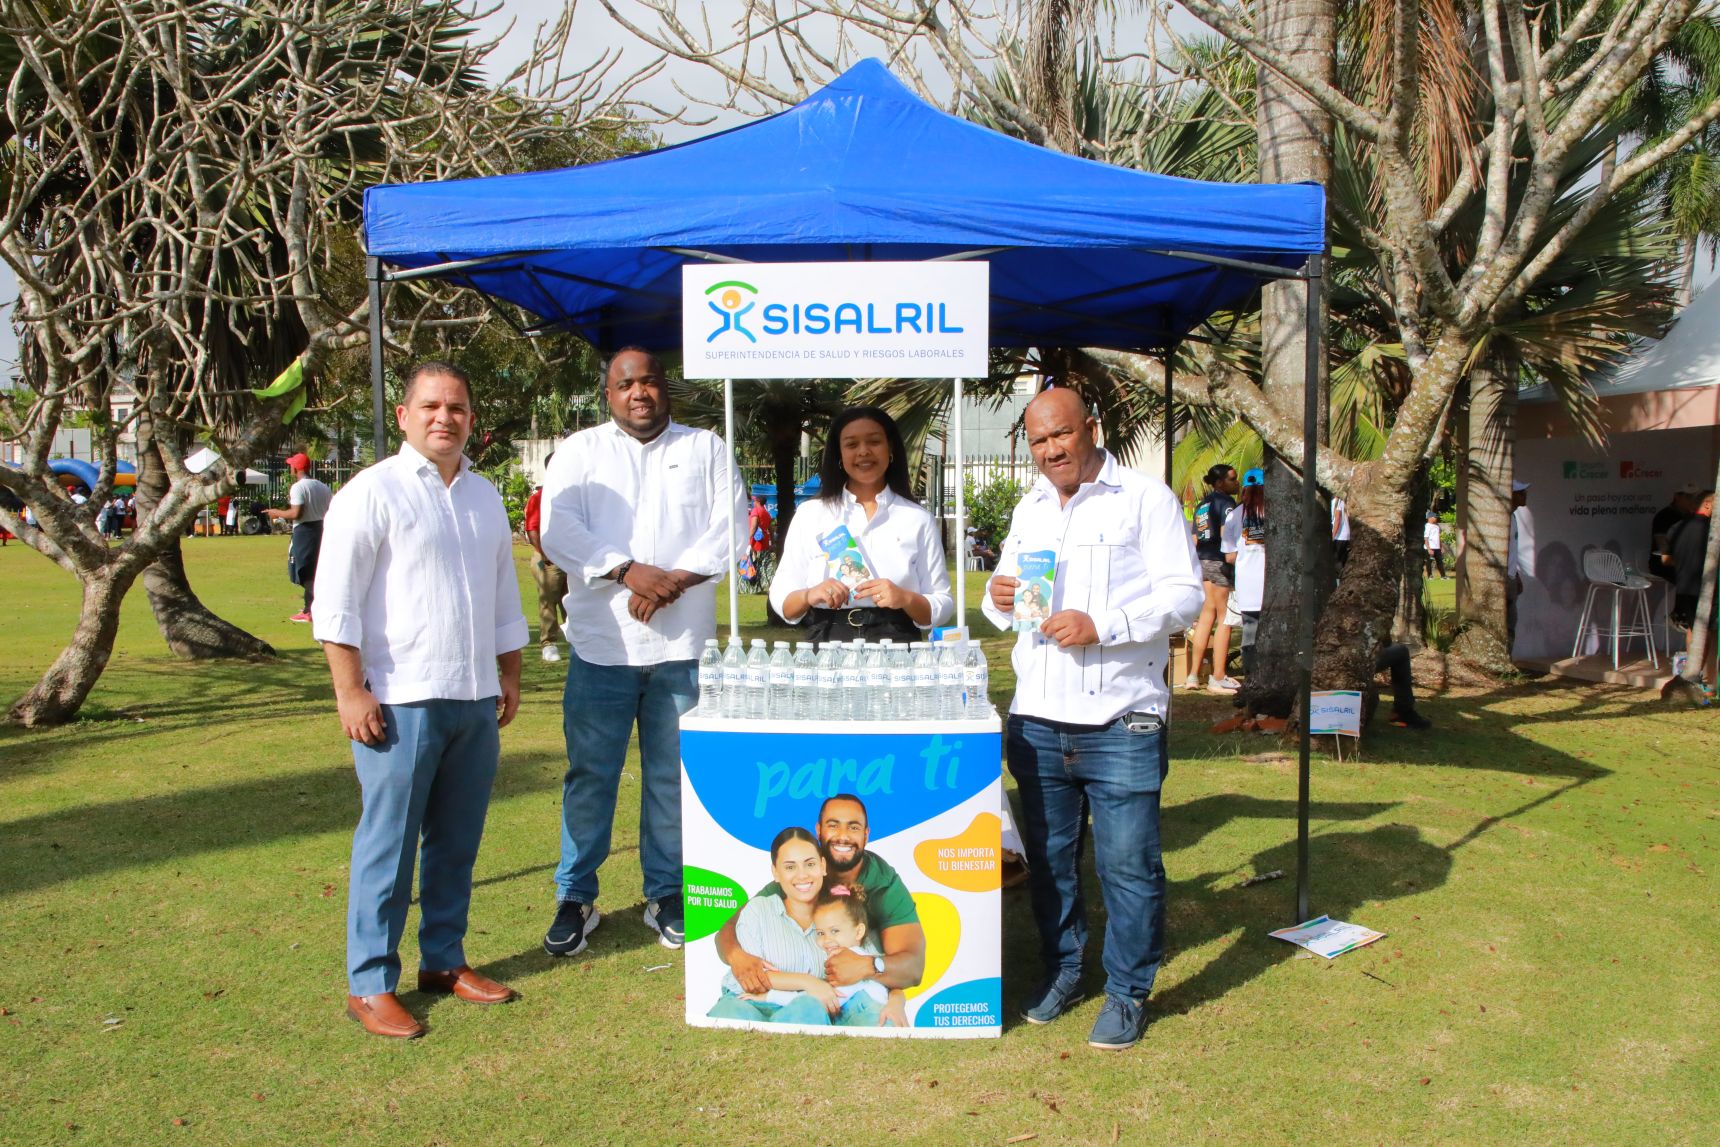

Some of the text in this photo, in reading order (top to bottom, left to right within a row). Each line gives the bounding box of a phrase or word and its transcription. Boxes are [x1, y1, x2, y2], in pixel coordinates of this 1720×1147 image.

[763, 302, 964, 335] SISALRIL
[705, 349, 964, 360] SUPERINTENDENCIA DE SALUD Y RIESGOS LABORALES
[1569, 506, 1590, 515] vida
[1591, 506, 1618, 517] plena
[754, 734, 963, 818] para ti
[938, 847, 995, 858] NOS IMPORTA
[938, 860, 996, 871] TU BIENESTAR
[687, 884, 733, 897] TRABAJAMOS
[687, 896, 738, 909] POR TU SALUD
[933, 1002, 989, 1014] PROTEGEMOS
[934, 1014, 996, 1026] TUS DERECHOS
